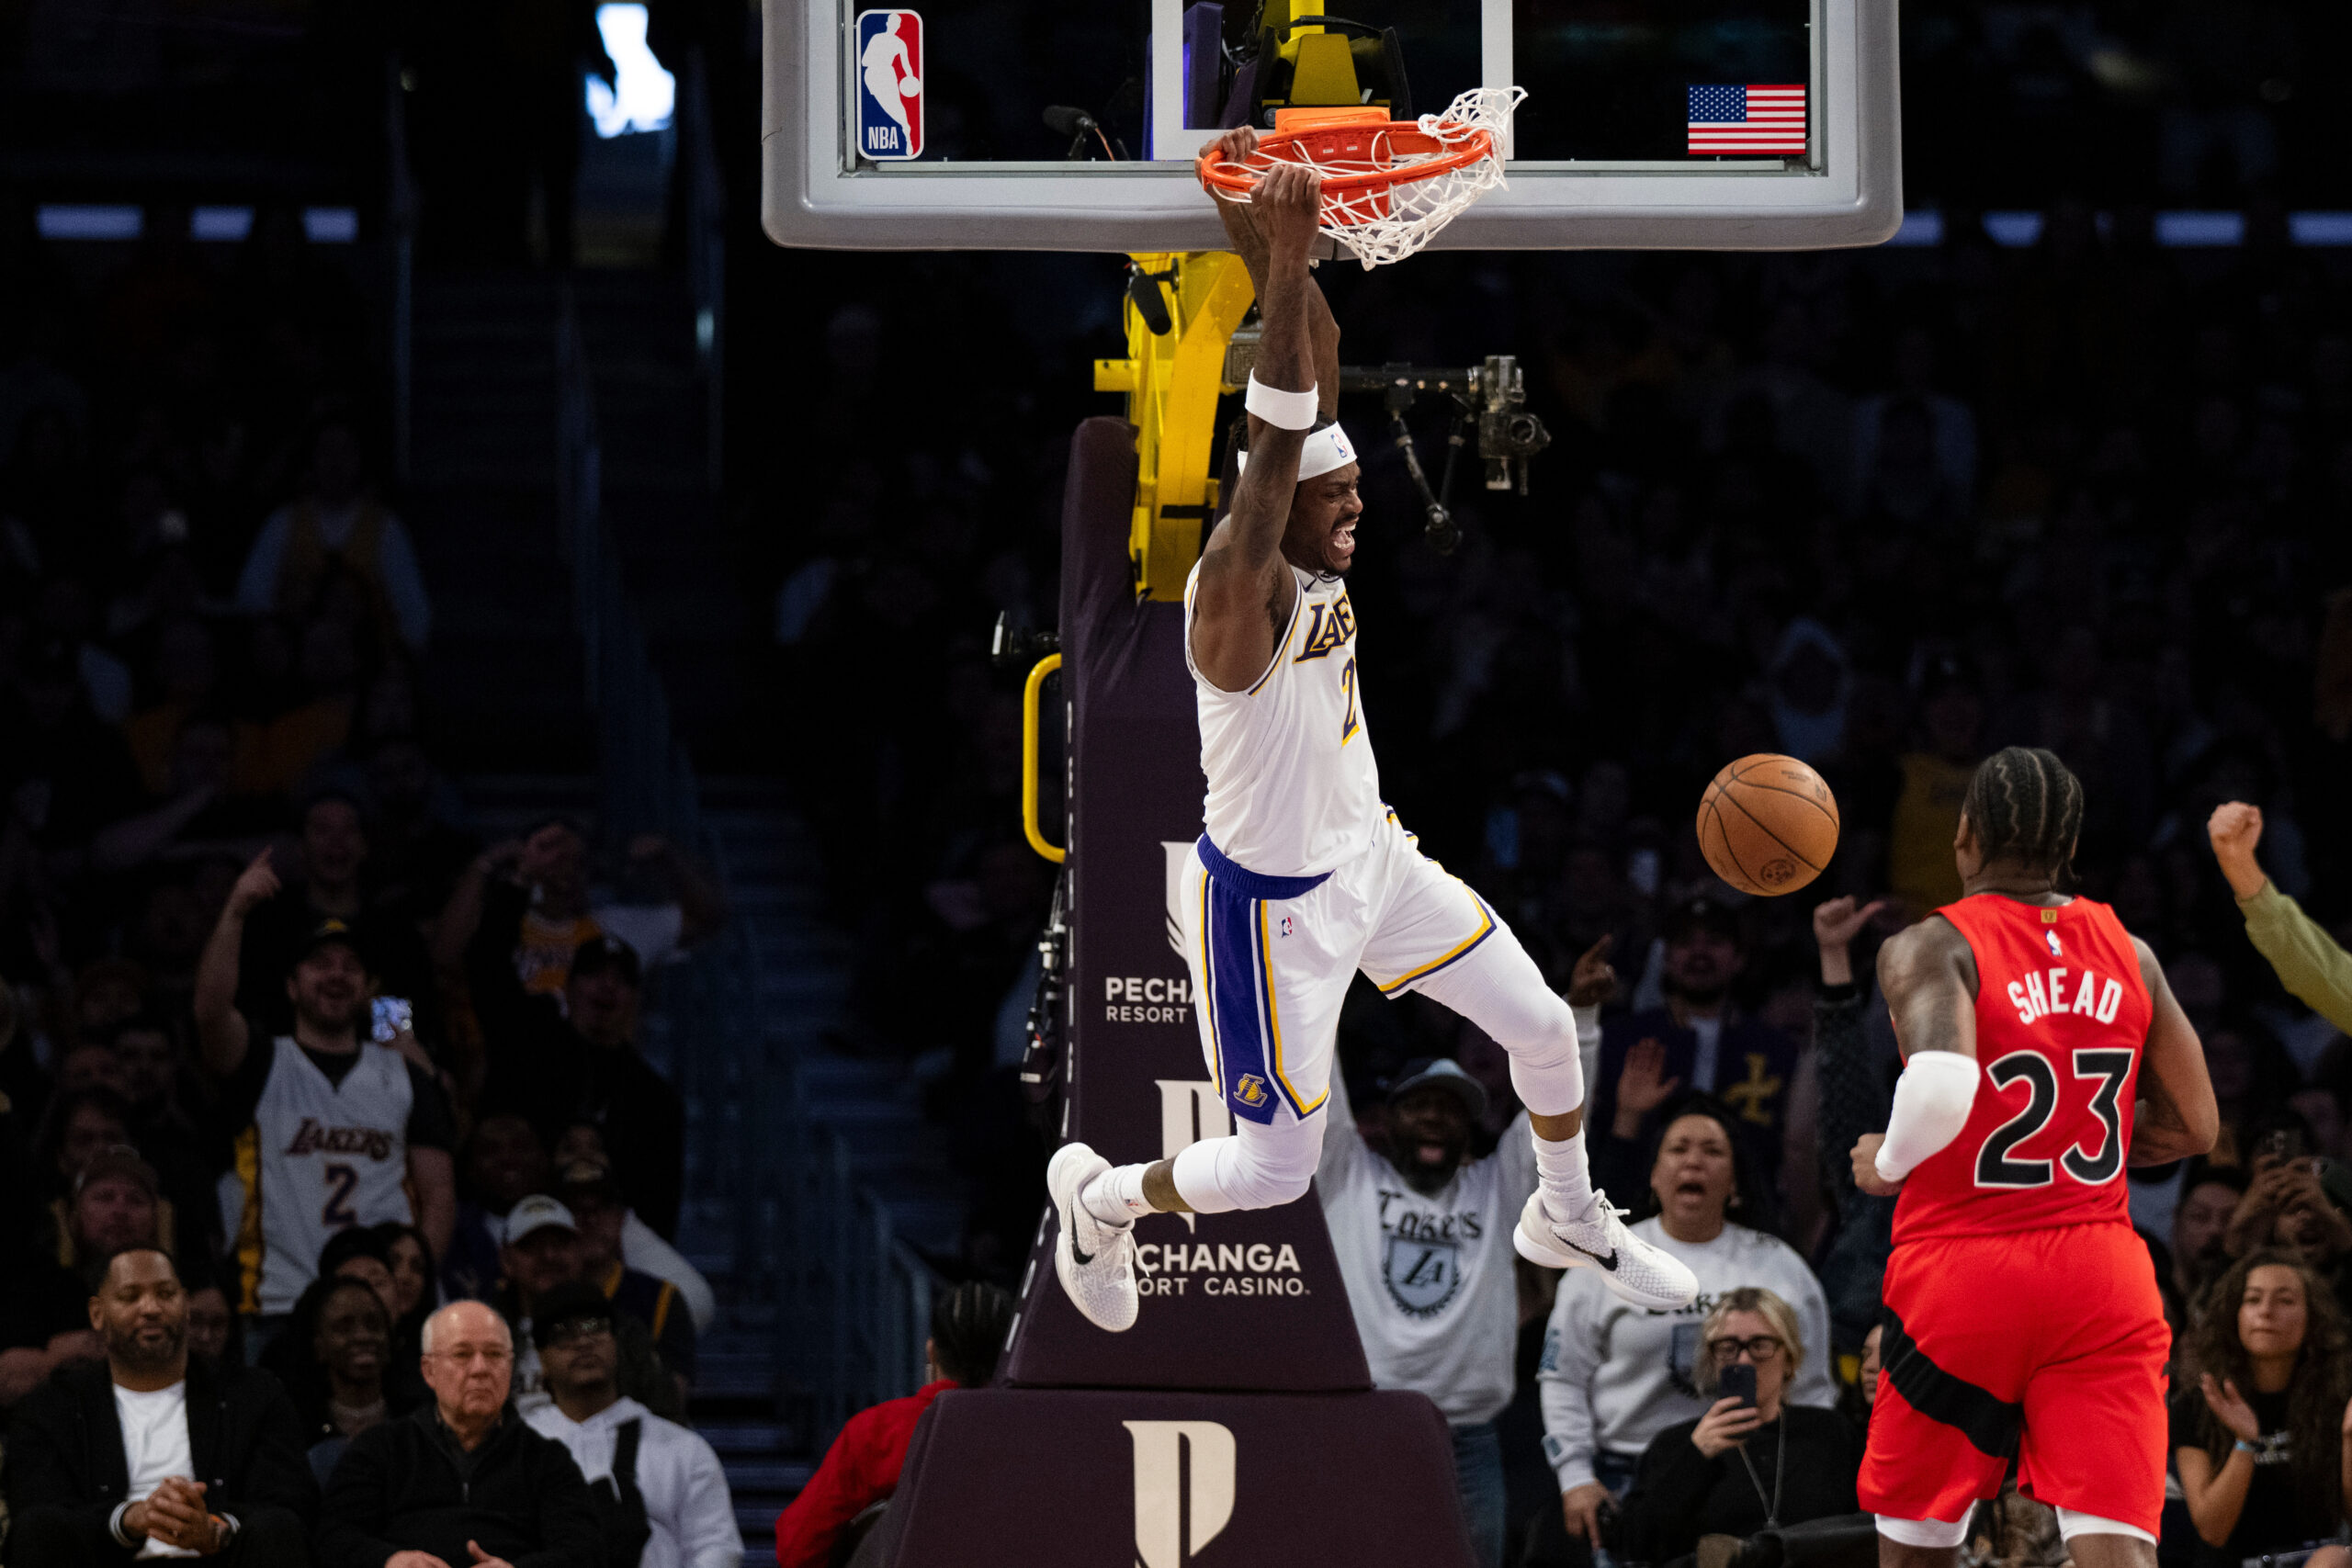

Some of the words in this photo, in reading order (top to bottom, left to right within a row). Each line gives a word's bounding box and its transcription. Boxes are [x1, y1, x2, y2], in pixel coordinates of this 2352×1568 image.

[868, 126, 899, 150] NBA
[1342, 655, 1361, 747] 2
[1105, 1005, 1188, 1024] RESORT
[2007, 967, 2123, 1025] SHEAD
[287, 1118, 393, 1161] LAKERS
[1974, 1048, 2136, 1188] 23
[322, 1165, 358, 1226] 2
[1204, 1277, 1305, 1297] CASINO
